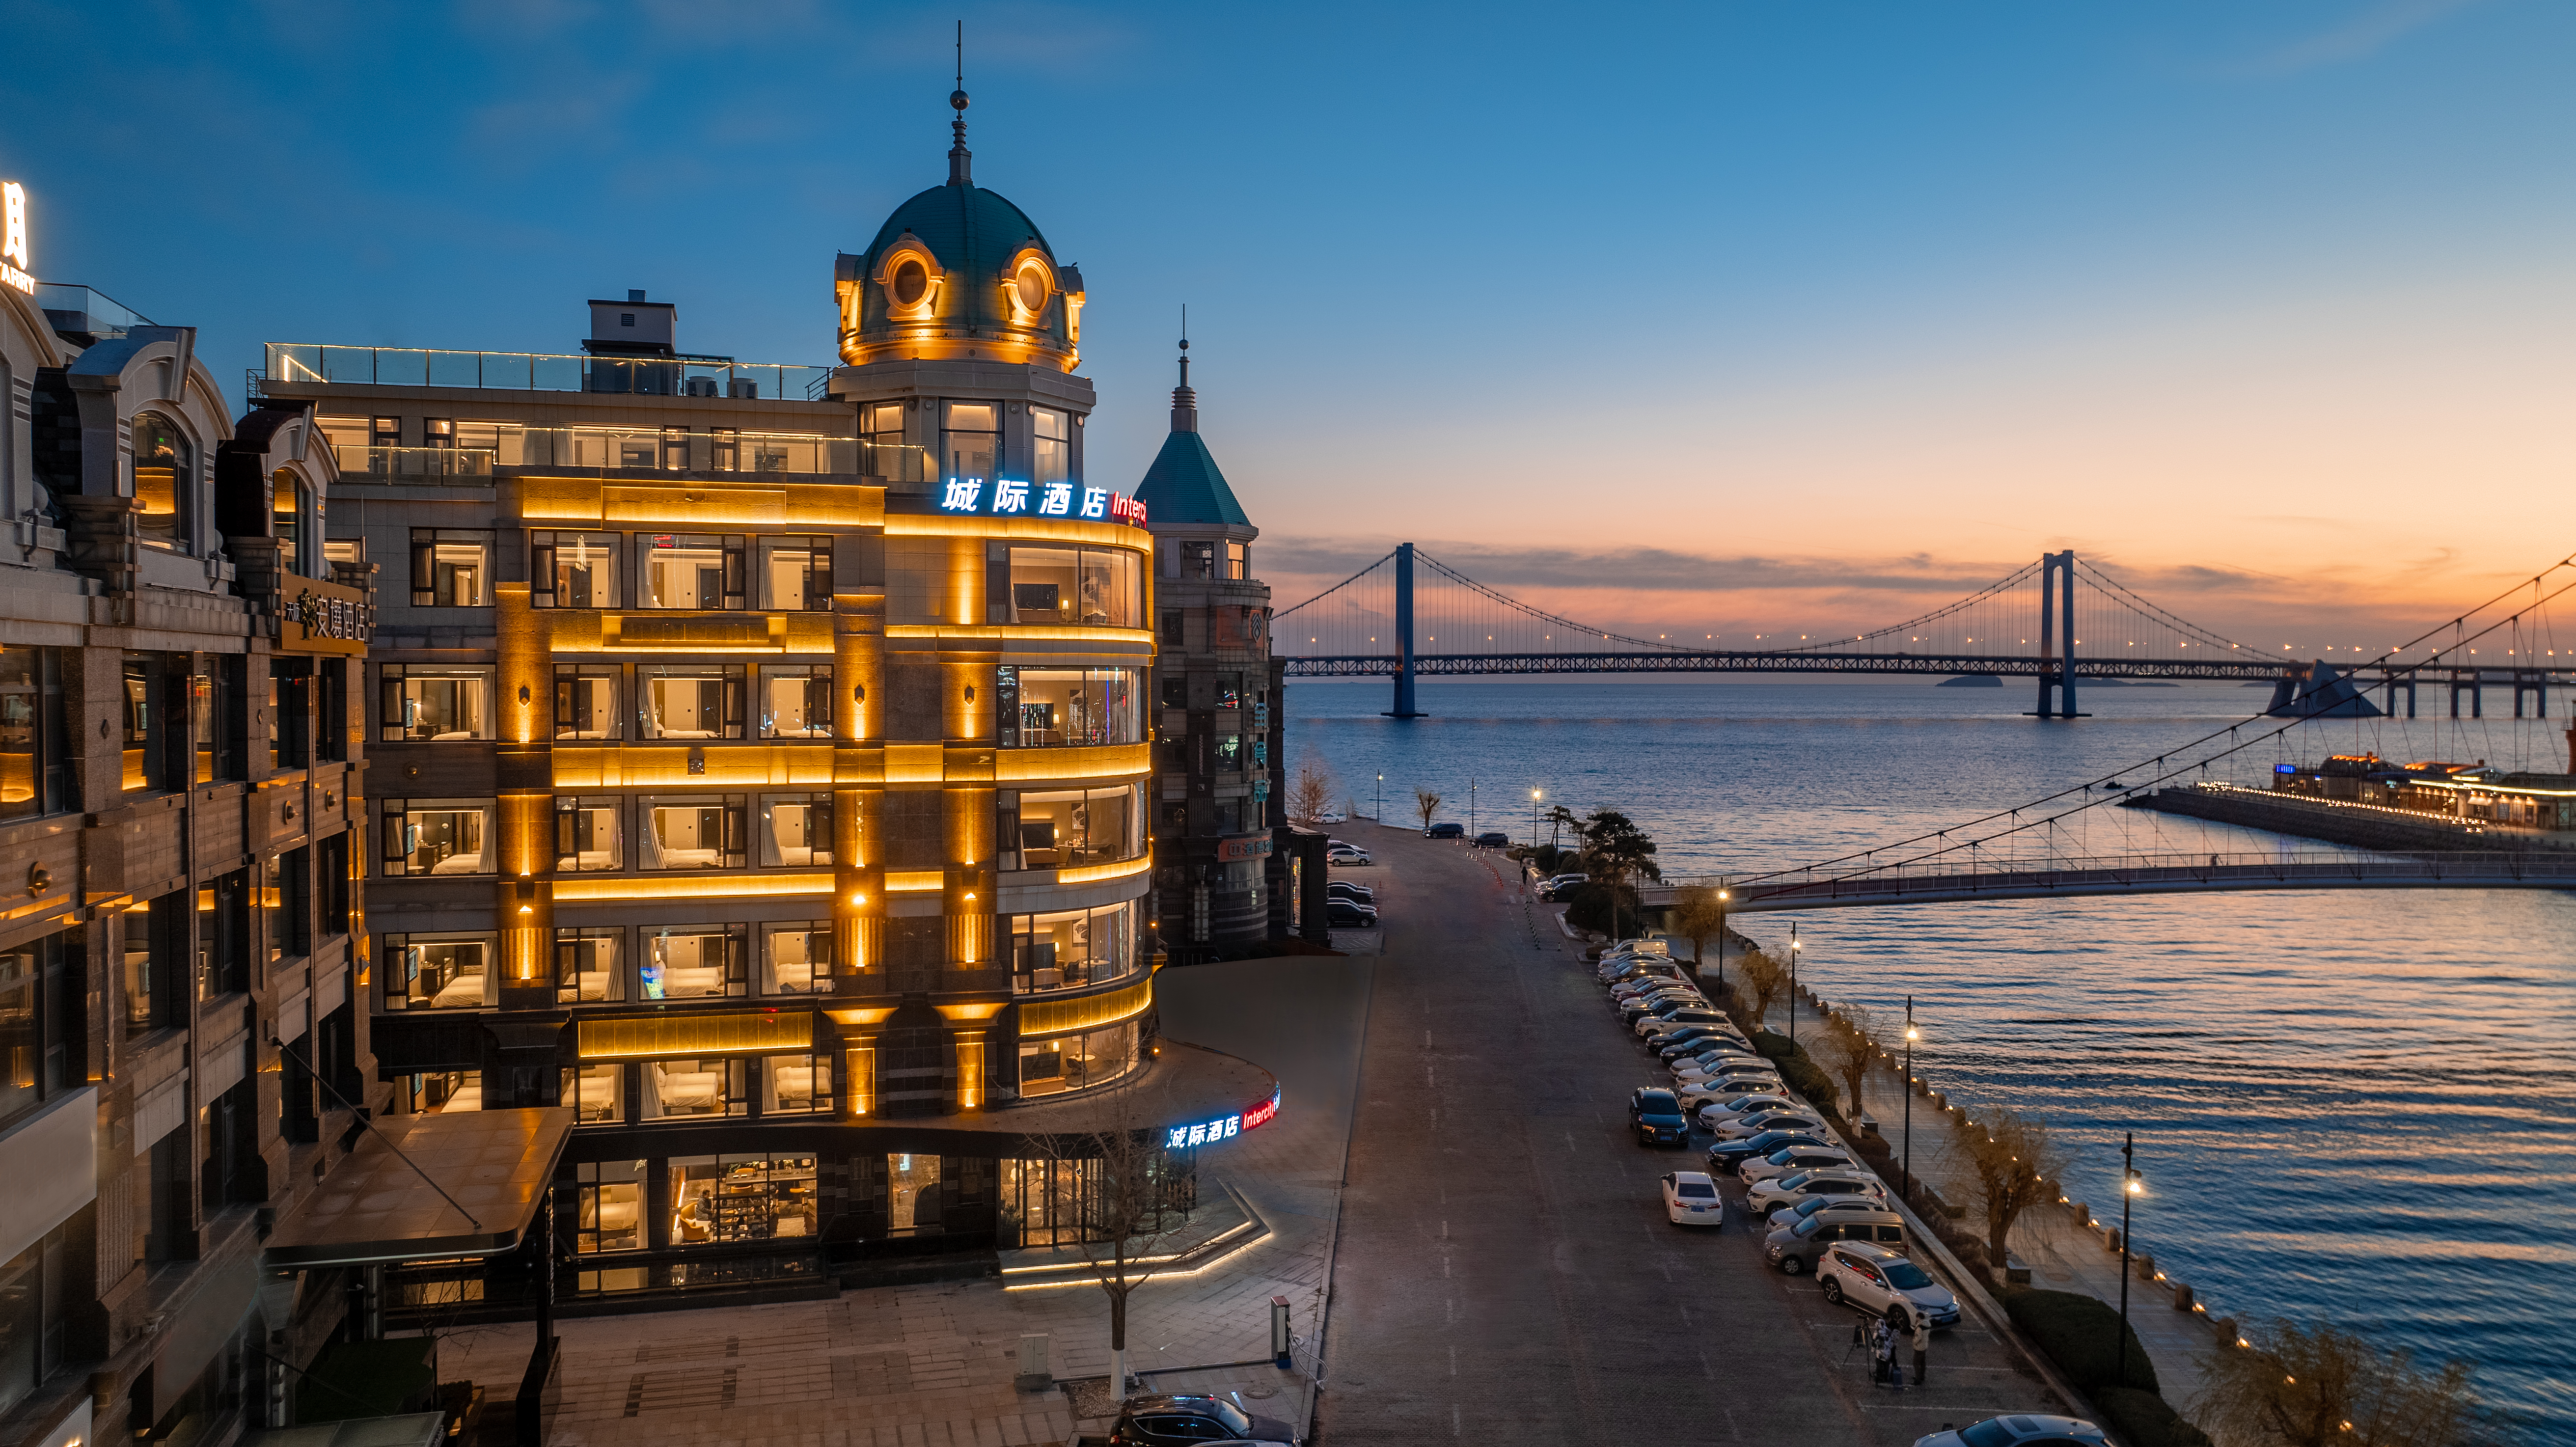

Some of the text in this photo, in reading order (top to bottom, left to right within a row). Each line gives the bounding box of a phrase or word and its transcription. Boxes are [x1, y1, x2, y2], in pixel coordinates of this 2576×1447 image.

[0, 261, 35, 296] ARRY
[942, 477, 1107, 518] 城际酒店
